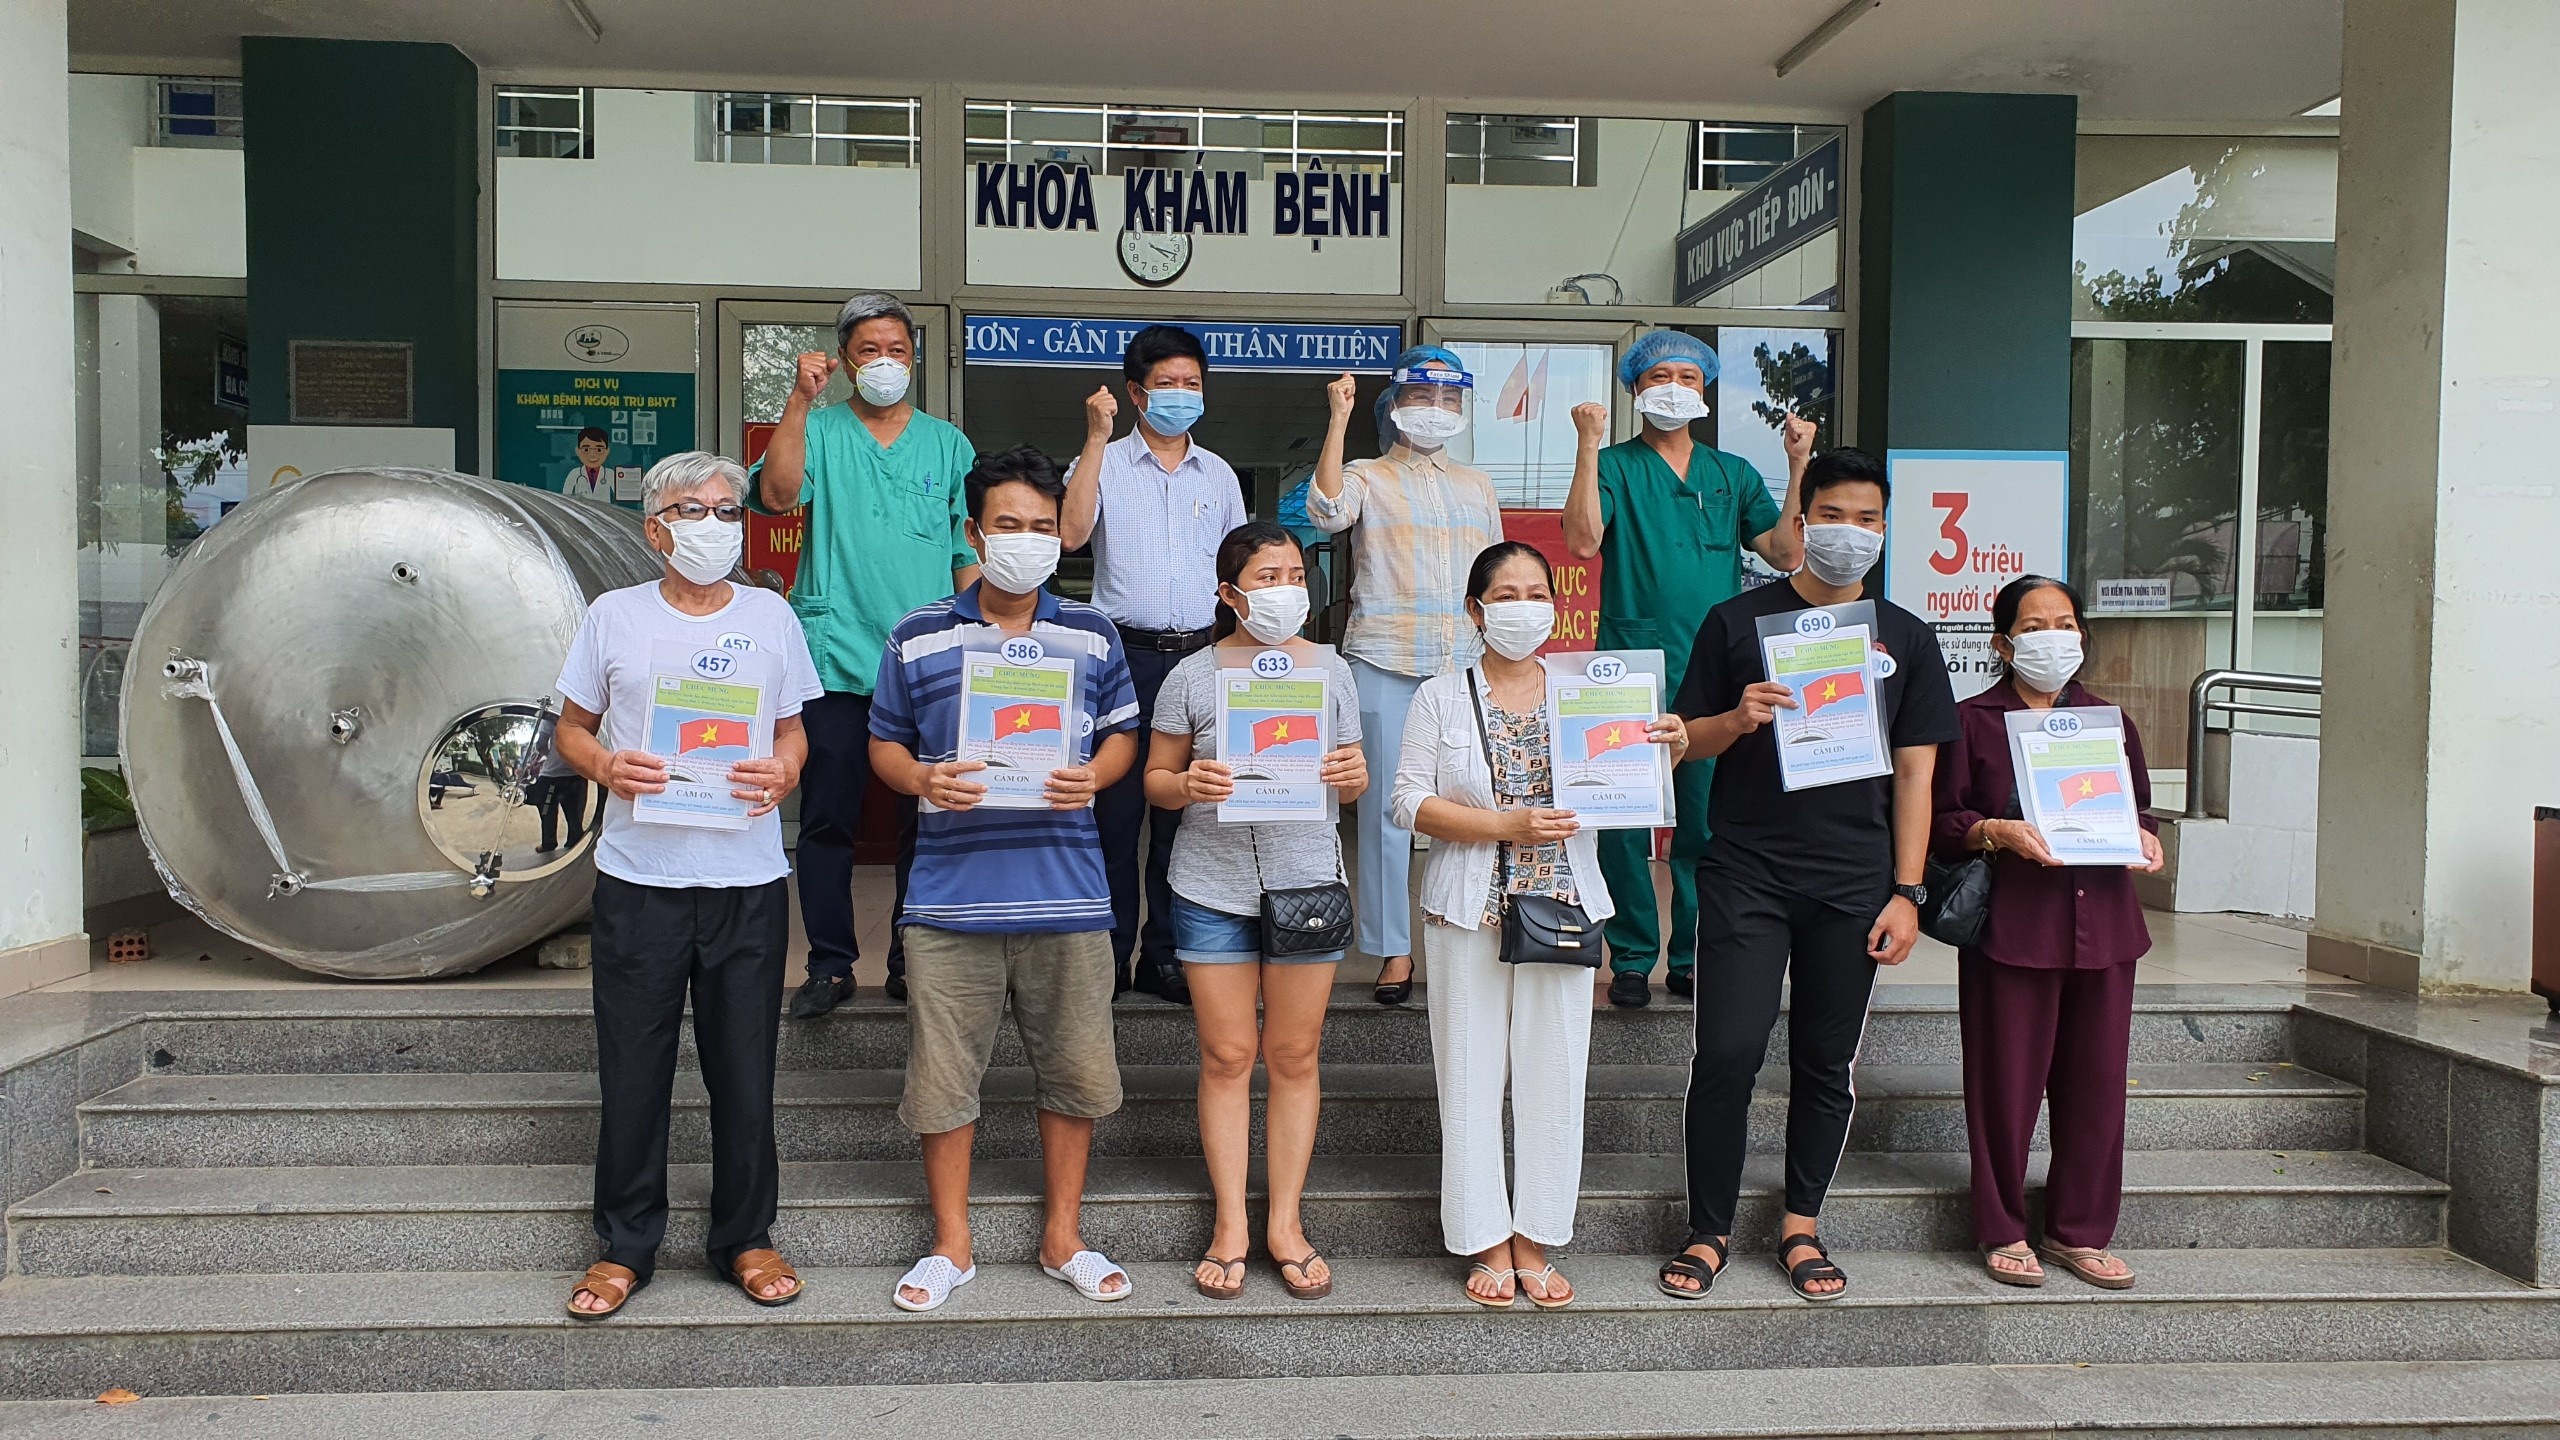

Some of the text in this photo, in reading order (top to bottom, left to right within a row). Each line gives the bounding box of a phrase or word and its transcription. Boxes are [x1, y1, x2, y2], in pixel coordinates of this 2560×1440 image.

[975, 149, 1390, 253] KHOA KHÁM BỆNH
[1687, 236, 1713, 286] KHU
[1717, 218, 1744, 271] VỰC
[1748, 187, 1781, 250] TIẾP
[1788, 167, 1824, 228] ĐÓN
[1173, 244, 1180, 252] 3
[1132, 254, 1139, 263] 8
[1141, 262, 1147, 270] 7
[1151, 265, 1158, 274] 6
[1162, 263, 1169, 271] 5
[1043, 320, 1109, 355] GẦN
[1204, 327, 1289, 358] THÂN
[1296, 329, 1390, 366] THIỆN
[574, 377, 619, 392] DỊCH VỤ
[516, 392, 550, 405] KHÁM
[553, 392, 581, 407] BỆNH
[584, 394, 620, 408] NGOẠI
[647, 396, 677, 408] BHYT
[770, 522, 803, 553] NHÂ
[1929, 492, 2024, 581] 3 triệu
[2124, 586, 2133, 596] TRA
[1927, 585, 1979, 619] người
[1801, 616, 1831, 633] 690
[1942, 624, 1964, 633] người
[1007, 644, 1038, 659] 586
[1961, 638, 1982, 652] dụng
[698, 656, 731, 672] 457
[1258, 657, 1288, 672] 633
[1592, 663, 1621, 678] 657
[1946, 653, 1968, 673] ỗi
[2049, 717, 2078, 732] 686
